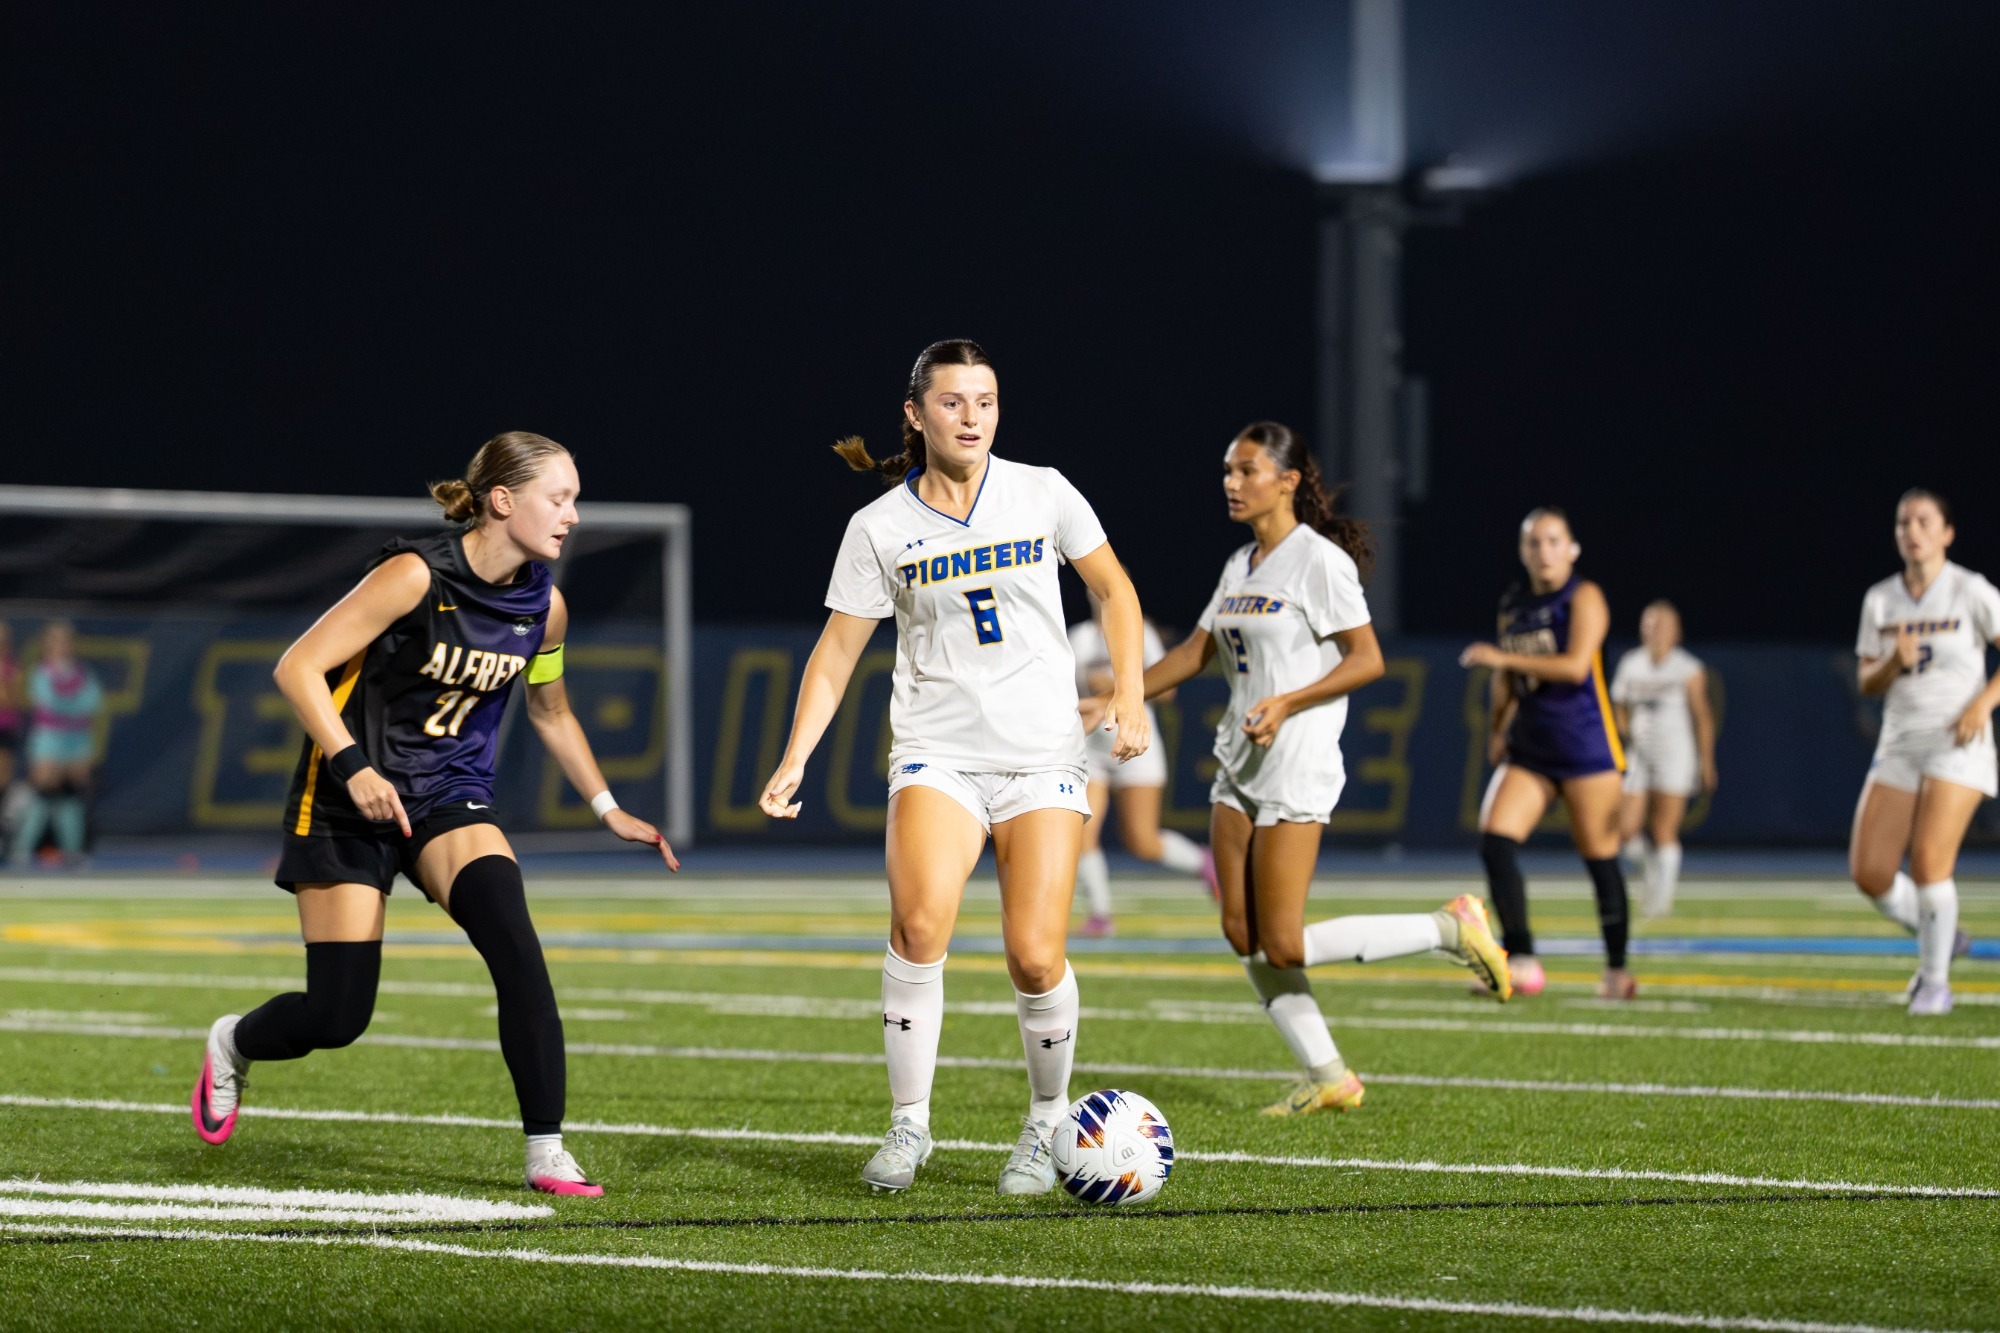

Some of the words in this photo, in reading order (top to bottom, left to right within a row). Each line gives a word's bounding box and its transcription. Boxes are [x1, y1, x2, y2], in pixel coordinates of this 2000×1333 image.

[896, 536, 1045, 590] PIONEERS
[961, 585, 1004, 647] 6
[419, 641, 527, 692] ALFRED
[1221, 627, 1249, 674] 12
[423, 690, 480, 737] 21
